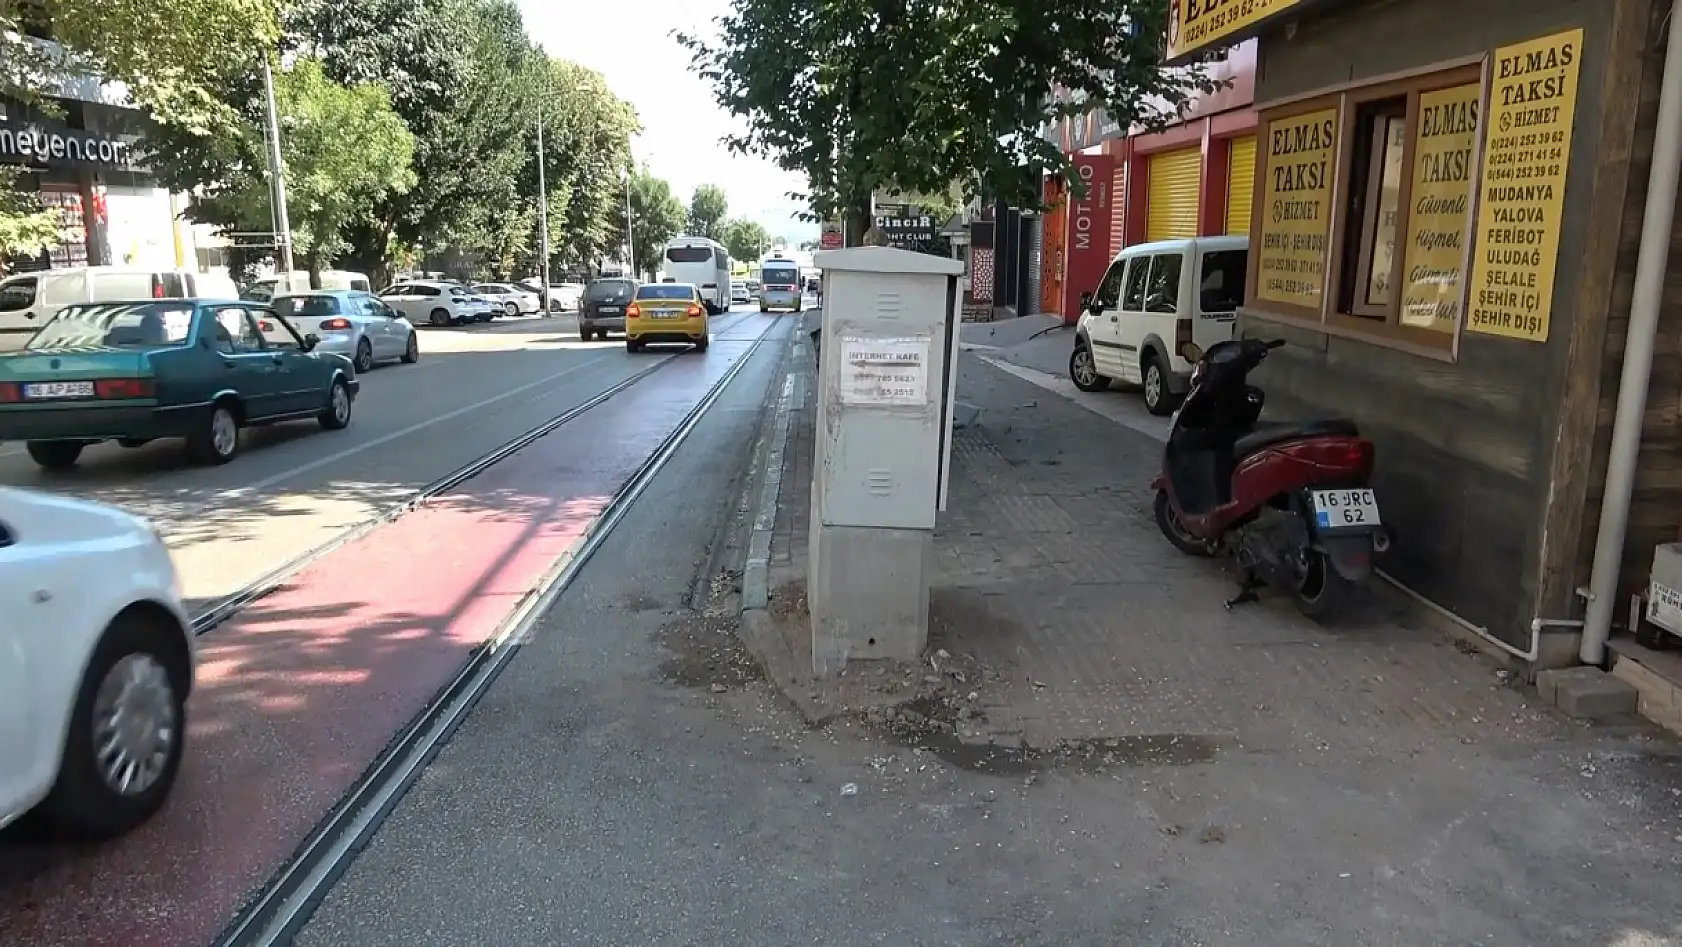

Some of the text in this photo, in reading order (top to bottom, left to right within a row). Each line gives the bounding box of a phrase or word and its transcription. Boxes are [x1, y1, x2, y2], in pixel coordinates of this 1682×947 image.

[1183, 21, 1208, 48] (0224)
[1209, 11, 1226, 32] 252
[1227, 5, 1240, 24] 39
[1241, 0, 1254, 17] 62
[1498, 43, 1573, 79] ELMAS
[1501, 68, 1566, 106] TAKSİ
[1420, 98, 1479, 138] ELMAS
[1514, 106, 1560, 128] HİZMET
[1271, 119, 1333, 156] ELMAS
[1491, 130, 1564, 151] 0(224) 252 39 62
[1421, 140, 1471, 184] TAKSİ
[1518, 150, 1534, 163] 271
[1536, 148, 1548, 161] 41
[1274, 153, 1327, 193] TAKSİ
[1516, 166, 1533, 179] 252
[1534, 166, 1546, 178] 39
[1548, 165, 1560, 176] 62
[1416, 193, 1466, 215] Güvenli
[1488, 184, 1553, 203] MUDANYA
[1283, 197, 1320, 221] HİZMET
[1493, 206, 1544, 223] YALOVA
[906, 232, 932, 240] CLUB
[1487, 225, 1545, 244] FERİBOT
[1487, 248, 1541, 266] ULUDAĞ
[1486, 270, 1537, 288] ŞELALE
[1478, 289, 1541, 312] ŞEHİR İÇİ
[1473, 308, 1542, 334] ŞEHİR DIŞI
[849, 351, 919, 361] INTERNET KAFE
[1319, 492, 1372, 507] 16 JRC
[1343, 508, 1364, 523] 62
